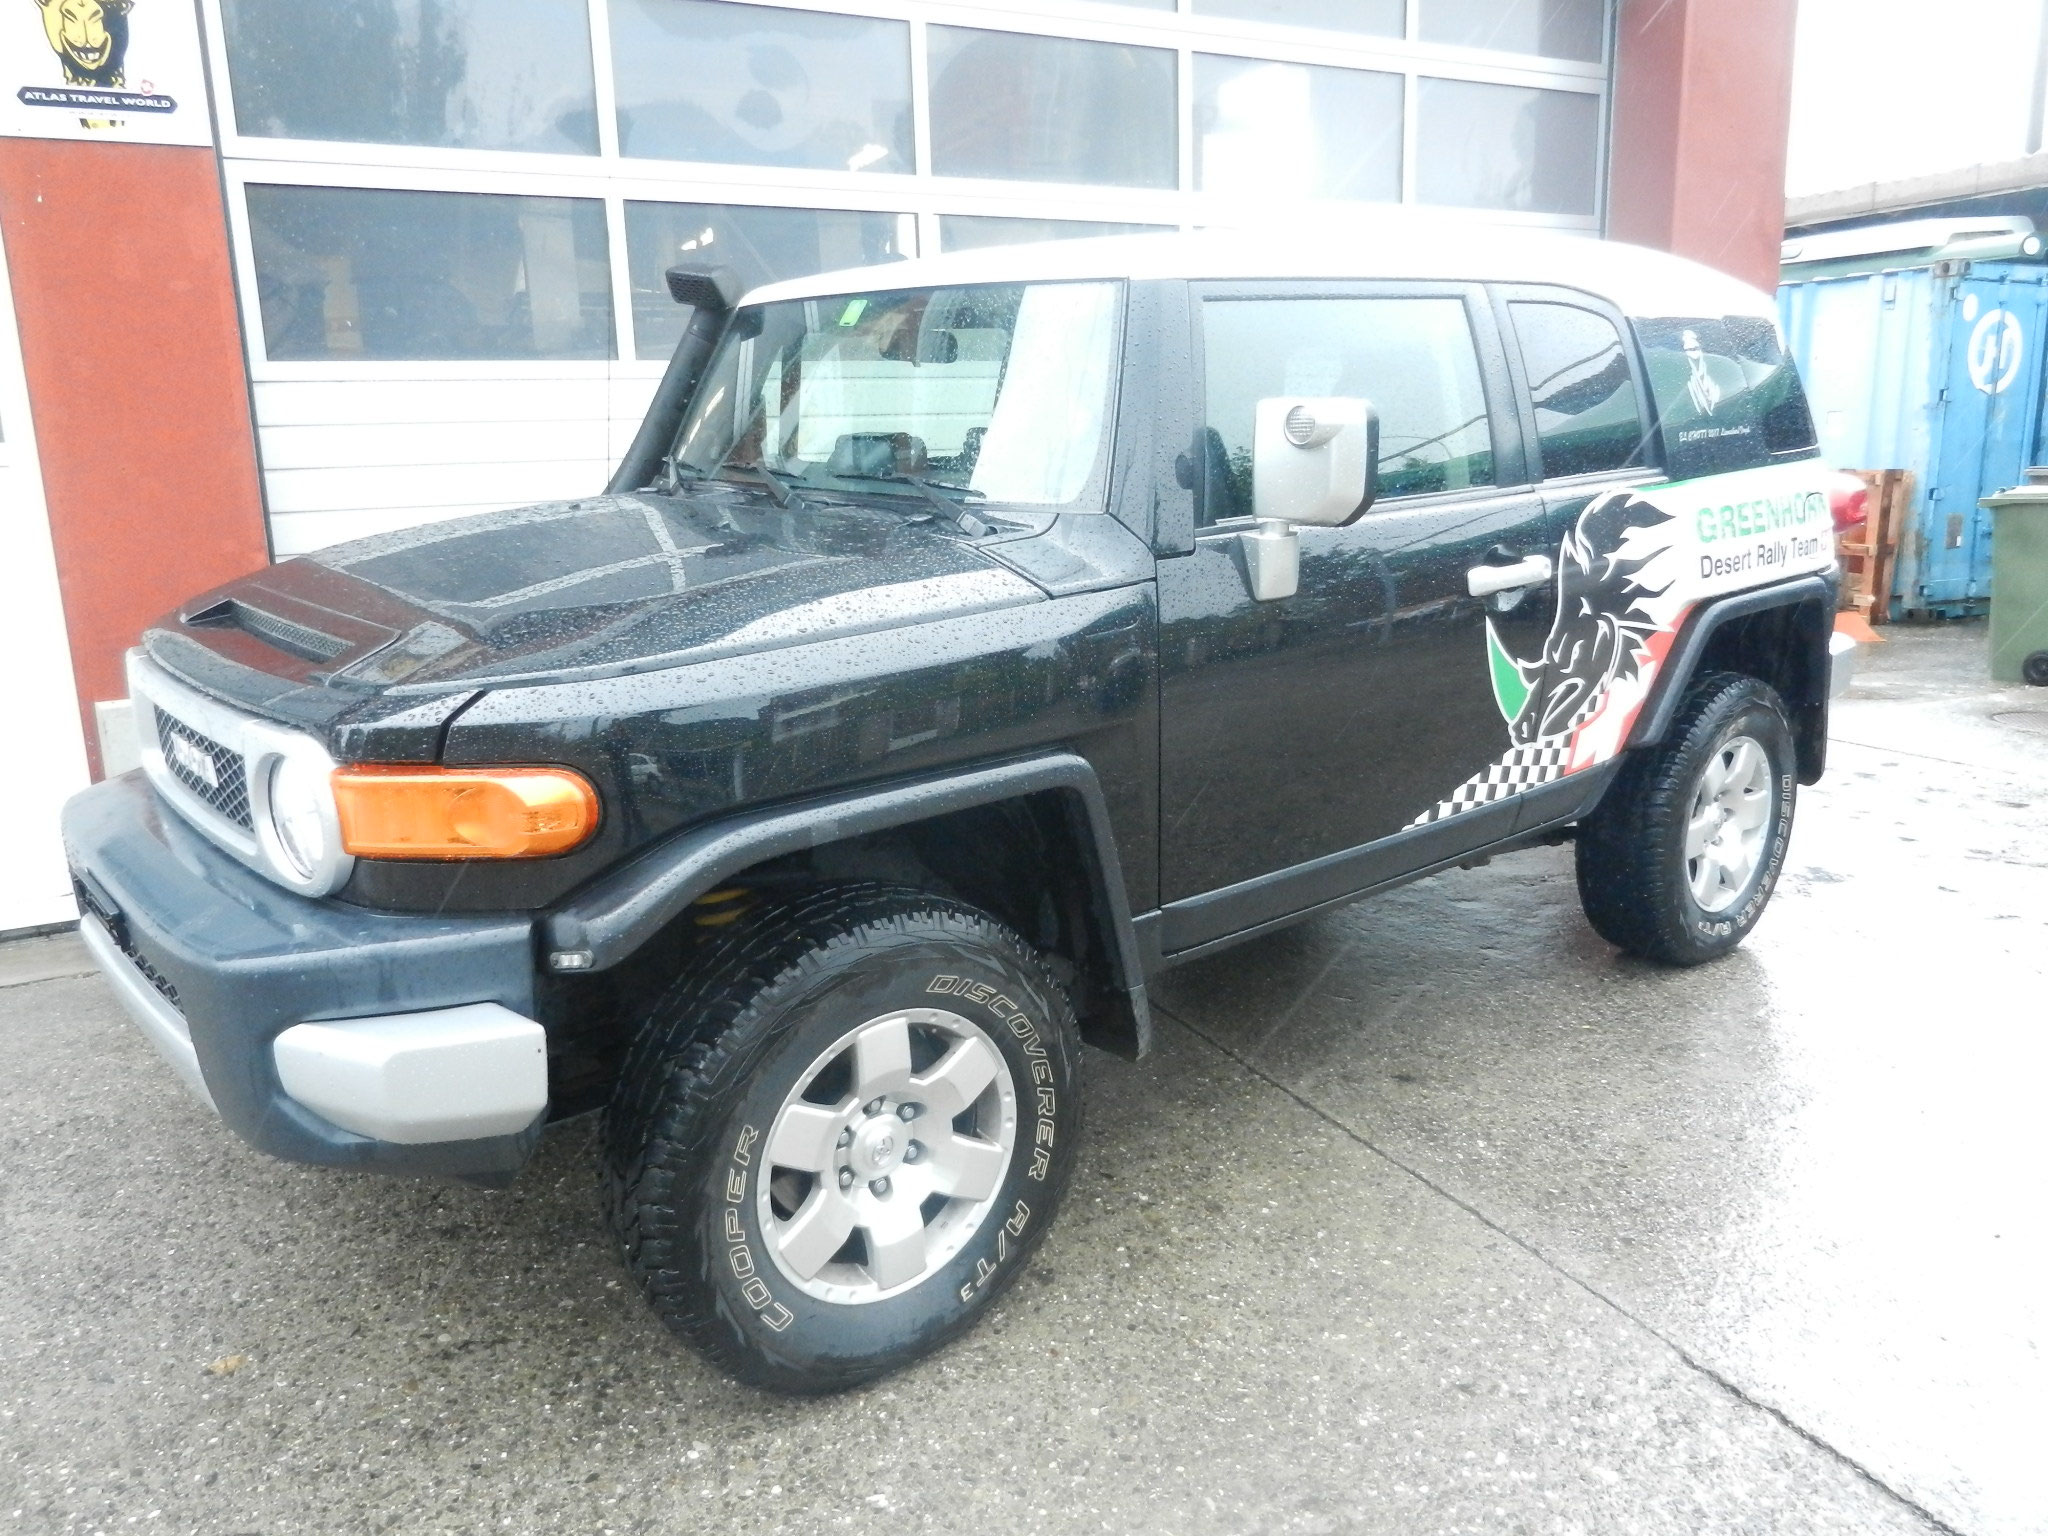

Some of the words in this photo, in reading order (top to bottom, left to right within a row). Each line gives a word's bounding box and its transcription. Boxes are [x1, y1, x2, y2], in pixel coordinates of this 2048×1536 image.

[24, 91, 67, 102] ATLAS
[71, 94, 120, 105] TRAVEL
[121, 97, 171, 108] WORLD
[1696, 491, 1826, 543] GREENHORN
[1700, 550, 1752, 578] Desert
[1757, 541, 1788, 567] Rally
[1791, 537, 1818, 559] Team
[1736, 774, 1792, 927] DISCOVERER
[926, 974, 1056, 1182] DISCOVERER
[725, 1125, 794, 1331] COOPER
